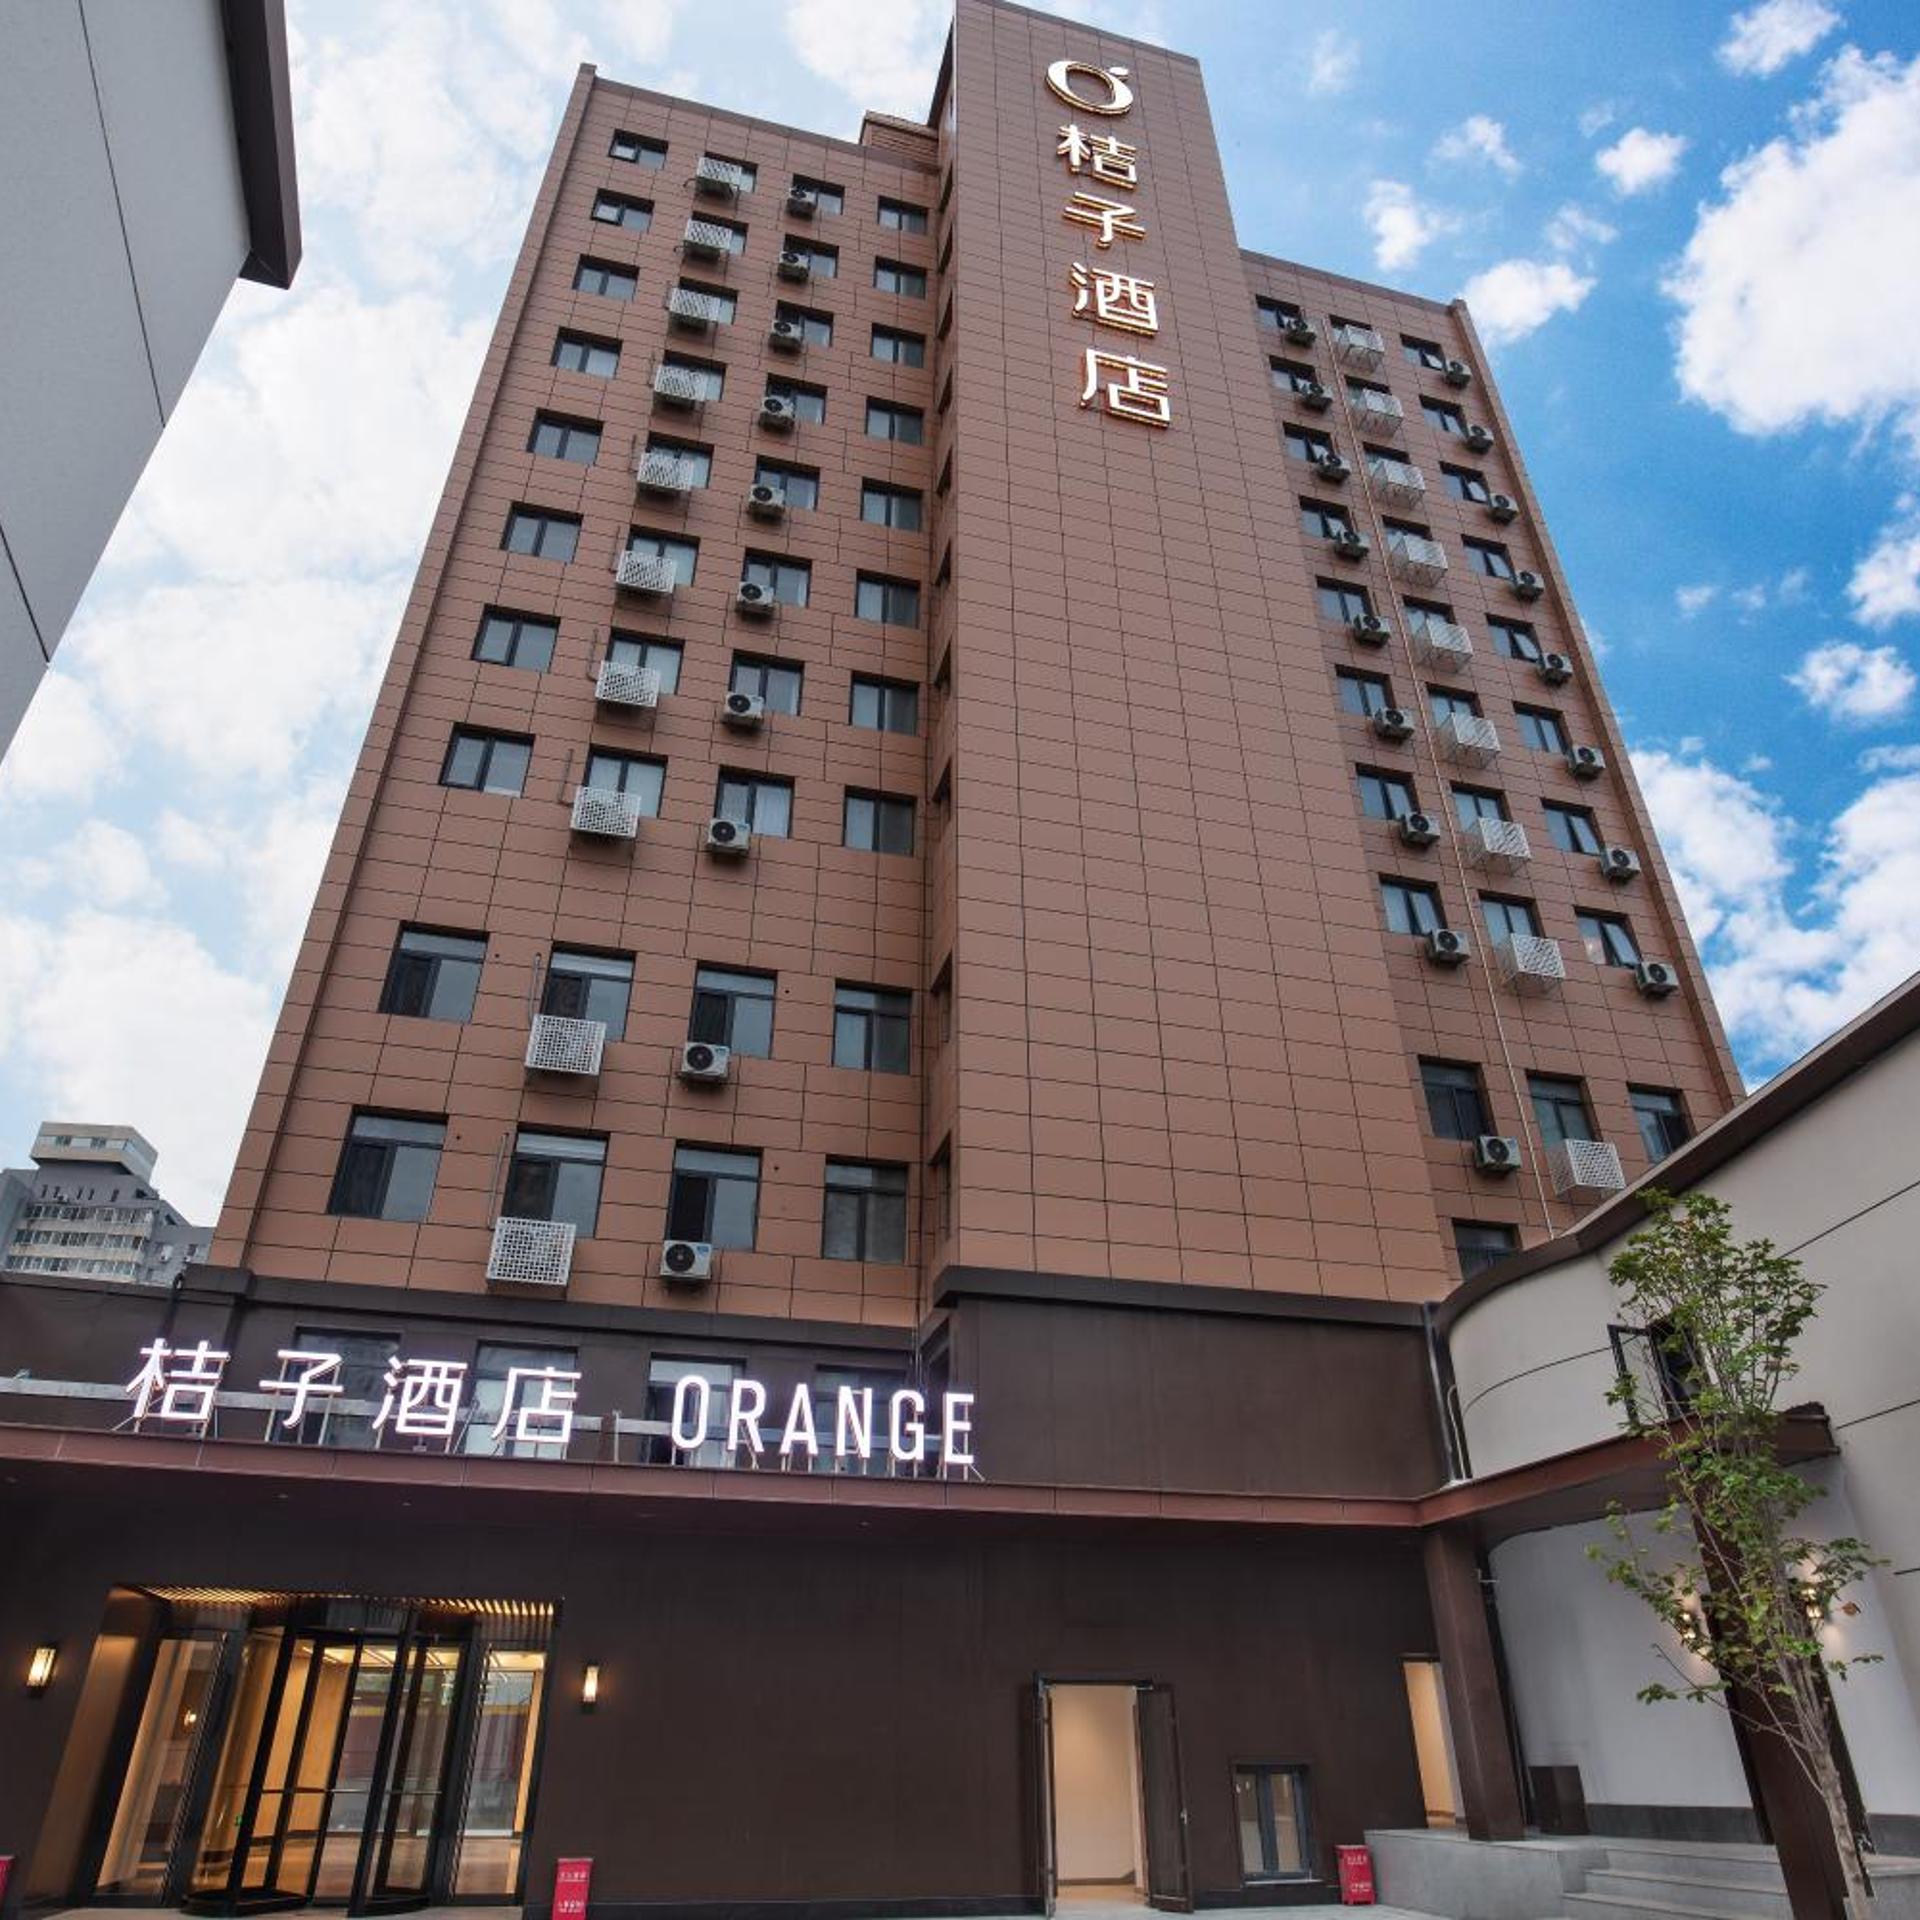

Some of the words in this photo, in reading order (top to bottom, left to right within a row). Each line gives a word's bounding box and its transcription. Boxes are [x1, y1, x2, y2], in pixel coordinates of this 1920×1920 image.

[1056, 124, 1172, 429] 桔子酒店
[125, 1337, 582, 1443] 桔子酒店
[671, 1374, 975, 1464] ORANGE
